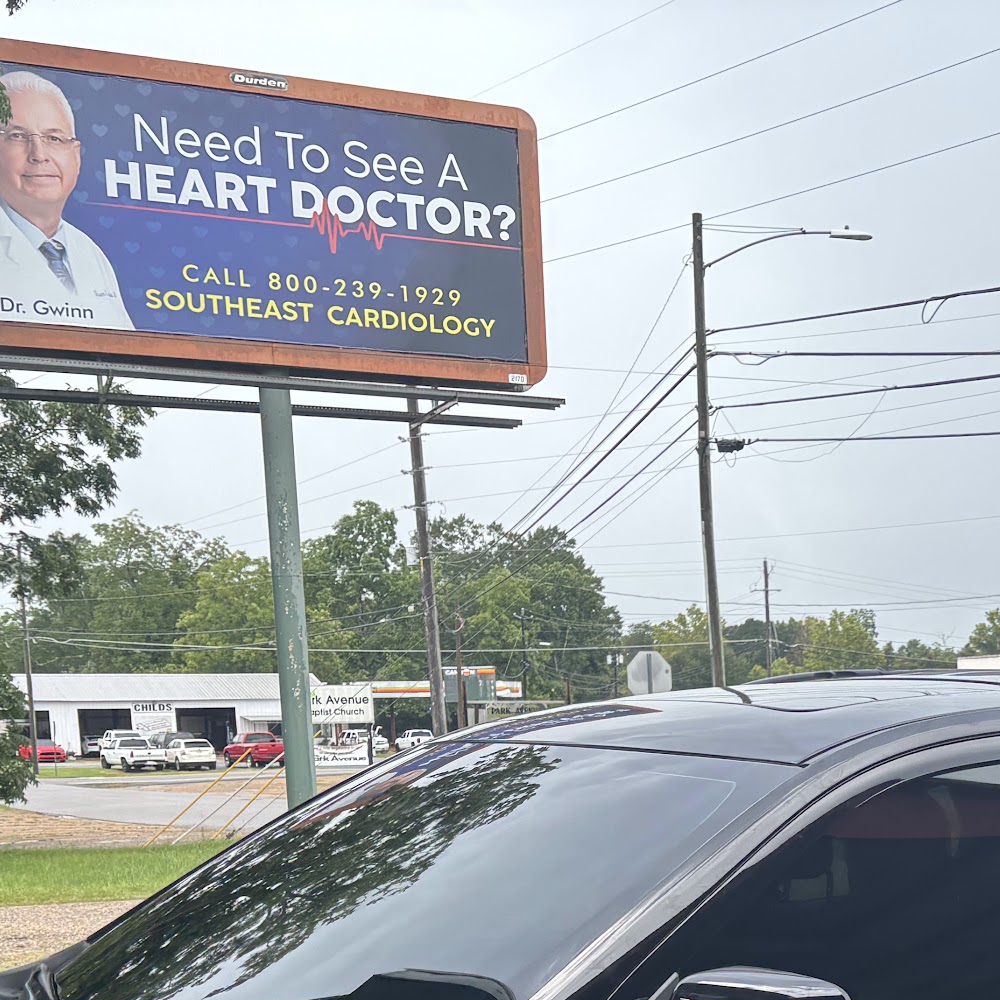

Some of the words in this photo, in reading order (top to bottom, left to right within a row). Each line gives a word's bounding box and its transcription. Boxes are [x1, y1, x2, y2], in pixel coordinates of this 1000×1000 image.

[233, 74, 286, 88] Durden
[134, 113, 262, 166] Need
[275, 131, 330, 174] To
[343, 140, 424, 186] See
[438, 153, 468, 191] A
[104, 158, 277, 214] HEART
[291, 180, 516, 241] DOCTOR?
[182, 264, 251, 288] CALL
[268, 272, 461, 307] 800-239-1929
[0, 297, 26, 314] Dr.
[33, 300, 94, 319] Gwinn
[145, 288, 314, 322] SOUTHEAST
[327, 305, 496, 338] CARDIOLOGY
[134, 703, 172, 711] CHILDS
[326, 695, 369, 705] Avenue
[311, 708, 332, 718] aptist
[333, 708, 365, 716] Church
